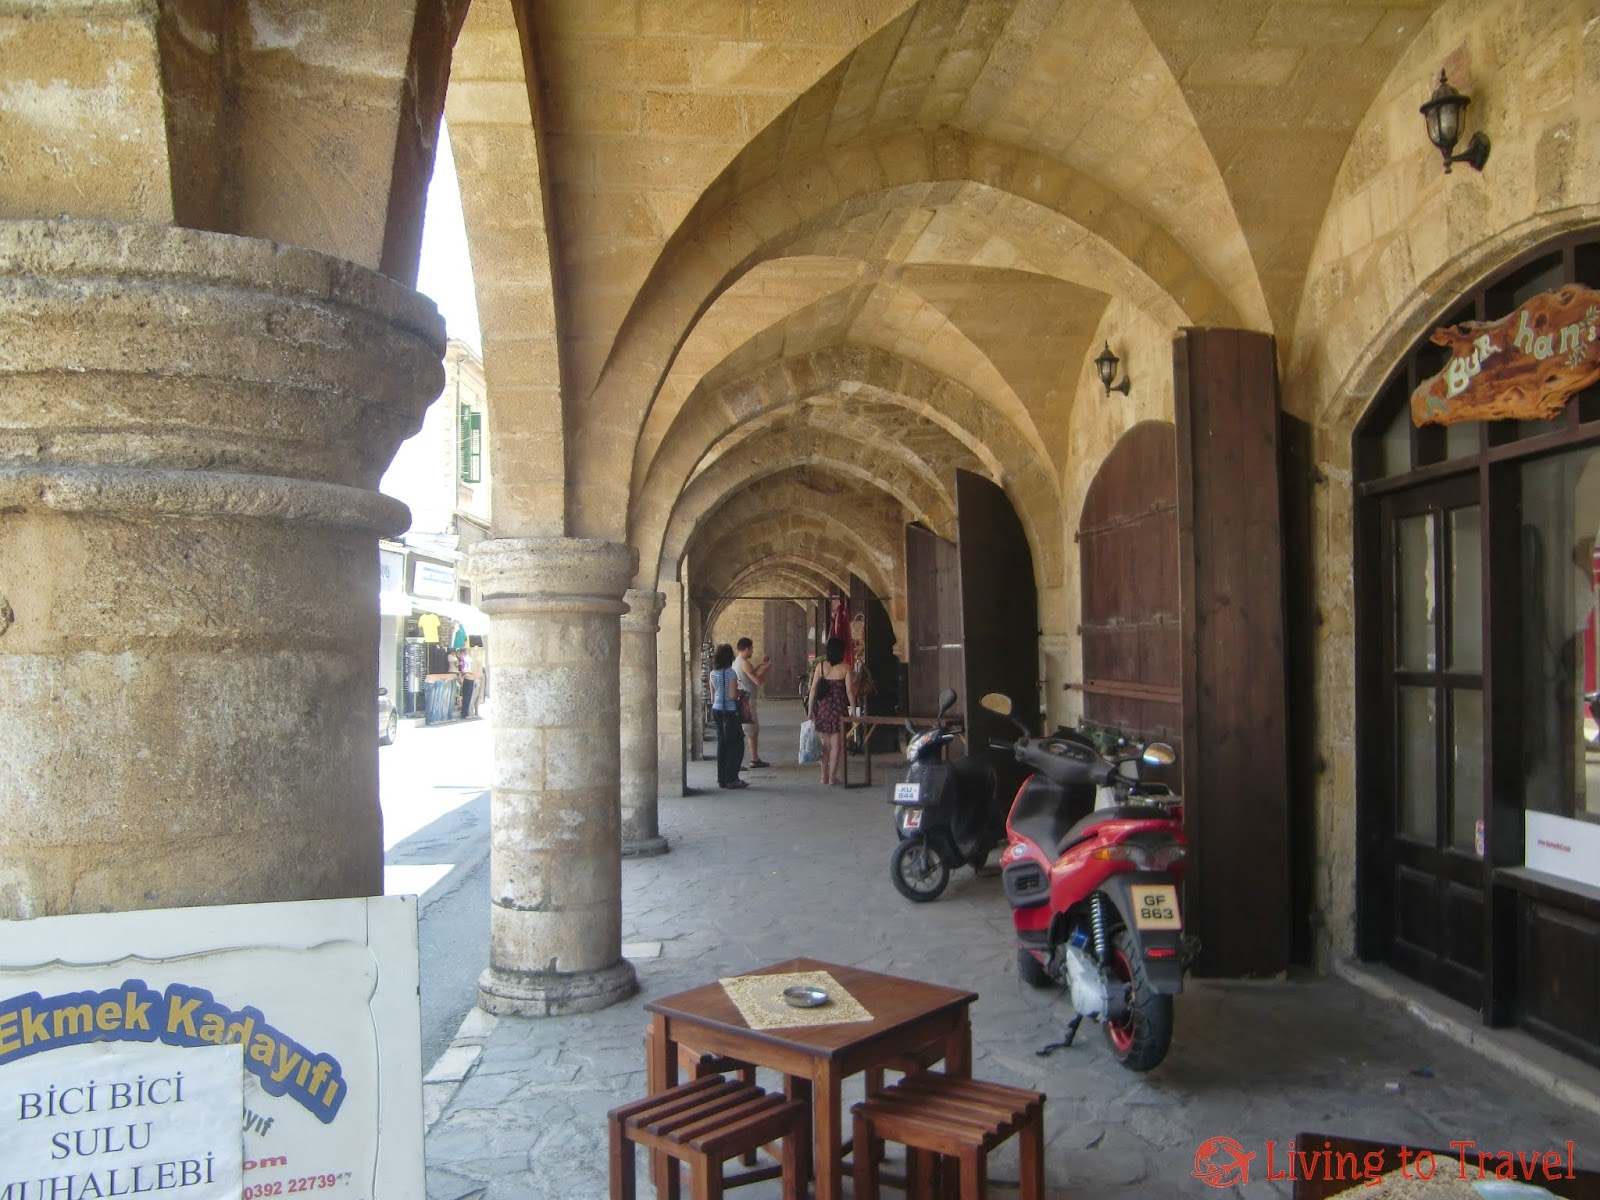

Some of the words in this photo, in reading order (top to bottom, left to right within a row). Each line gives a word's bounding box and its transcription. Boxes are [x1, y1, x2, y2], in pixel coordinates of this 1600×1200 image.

[1141, 908, 1173, 919] 863
[1144, 895, 1165, 906] GF
[0, 992, 152, 1056] Ekmek
[167, 995, 339, 1107] Kadayıfı
[18, 1079, 97, 1121] BİCİ
[109, 1070, 185, 1110] BİCİ
[51, 1121, 154, 1160] SULU
[243, 1180, 283, 1200] 0392
